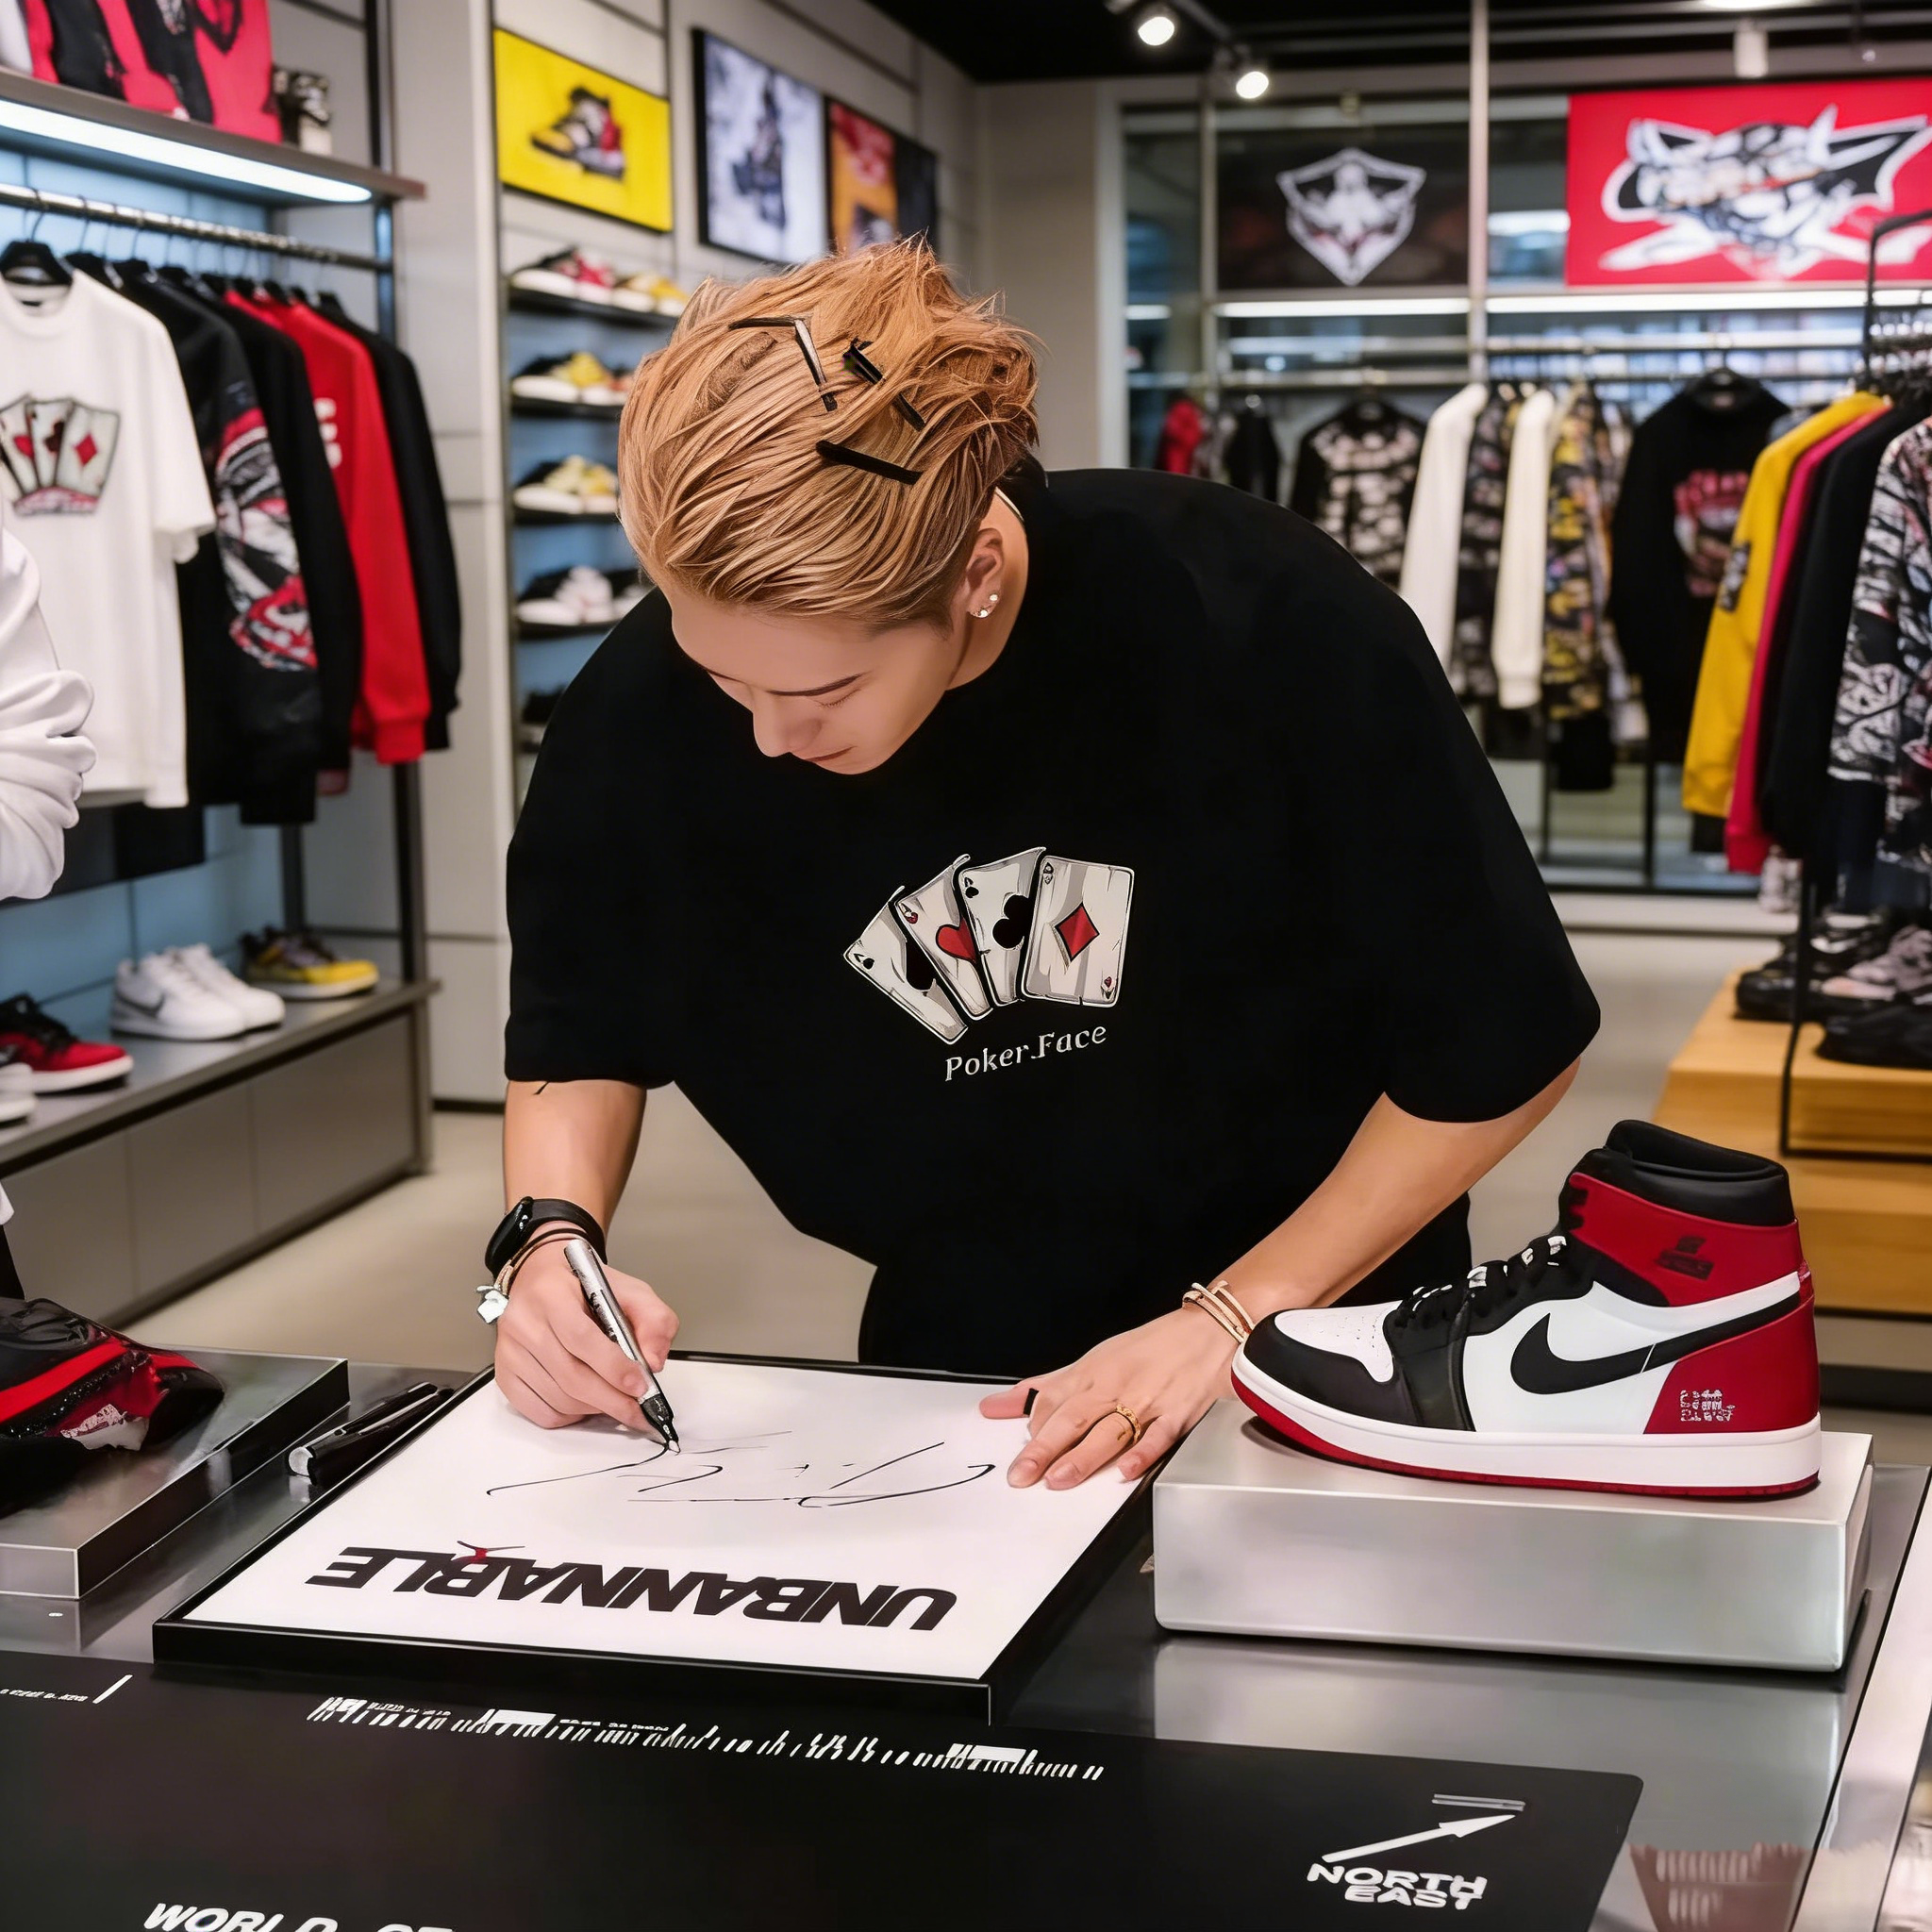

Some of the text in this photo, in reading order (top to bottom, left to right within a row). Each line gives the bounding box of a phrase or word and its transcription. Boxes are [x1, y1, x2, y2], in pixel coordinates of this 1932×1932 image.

[304, 1546, 957, 1631] UNBANNABLE
[1307, 1863, 1488, 1899] NORTH
[1344, 1886, 1483, 1911] EAST
